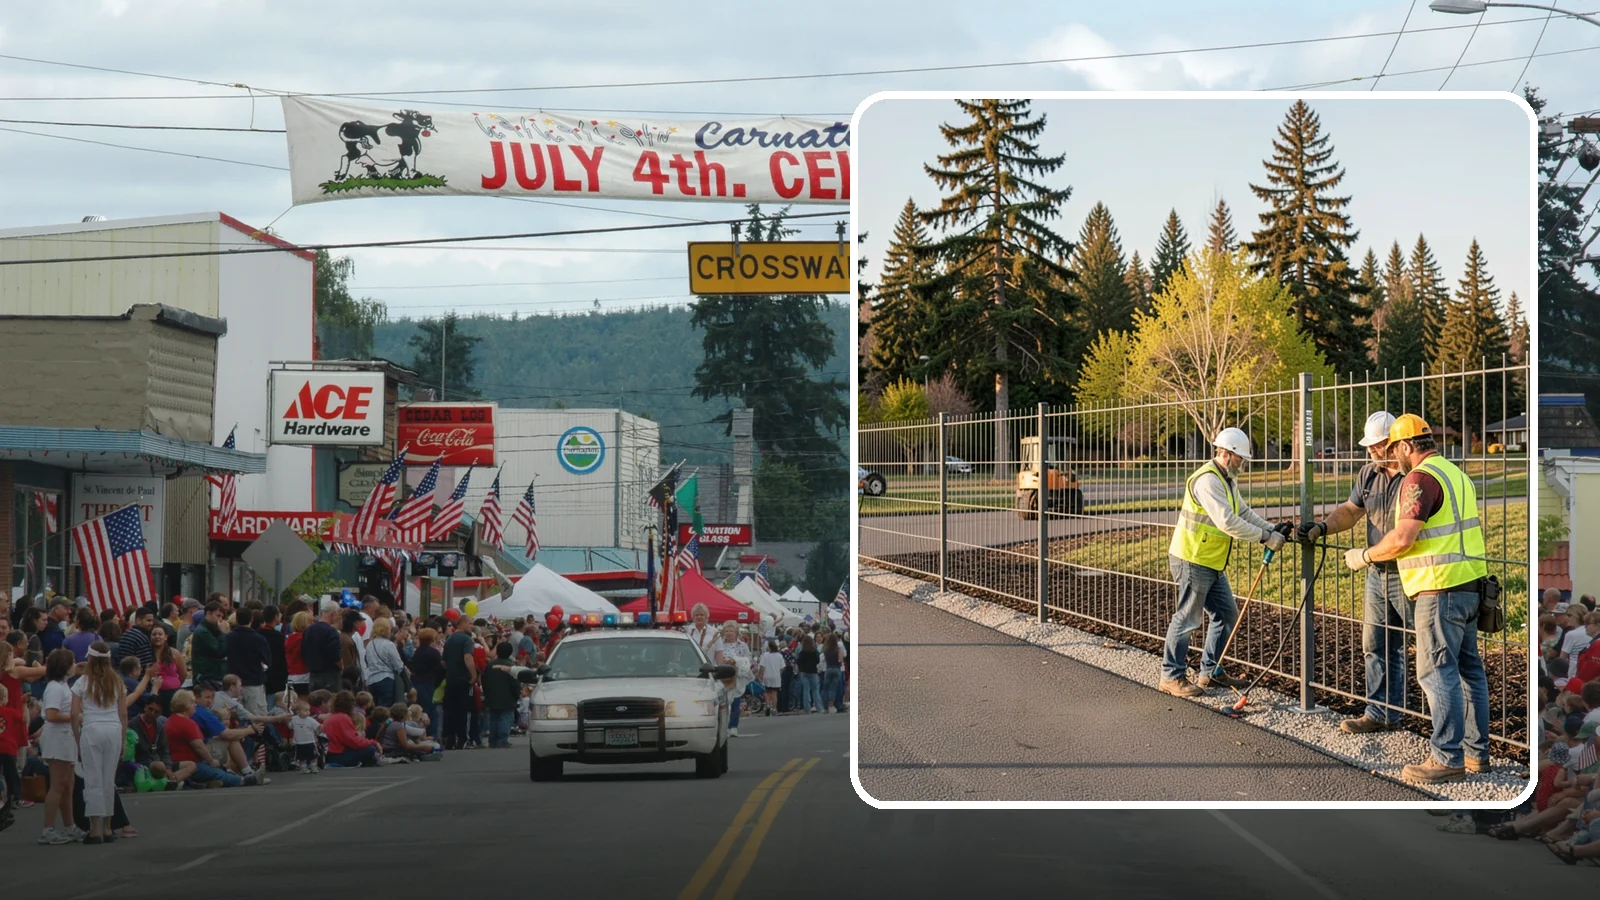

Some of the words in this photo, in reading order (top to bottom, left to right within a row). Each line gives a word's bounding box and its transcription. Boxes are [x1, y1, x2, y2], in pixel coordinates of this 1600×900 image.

[481, 141, 604, 192] JULY
[632, 149, 746, 197] 4th.
[697, 254, 850, 280] CROSSWA
[283, 380, 373, 420] ACE
[406, 409, 452, 422] CEDAR
[461, 409, 485, 422] LOG
[283, 421, 371, 437] Hardware
[416, 428, 477, 446] Coca-Cola
[83, 485, 93, 495] St.
[96, 485, 124, 495] Vincent
[126, 485, 136, 495] de
[138, 486, 155, 495] Paul
[81, 503, 154, 522] THRT
[688, 527, 741, 535] CRNATION
[699, 535, 730, 543] GLASS
